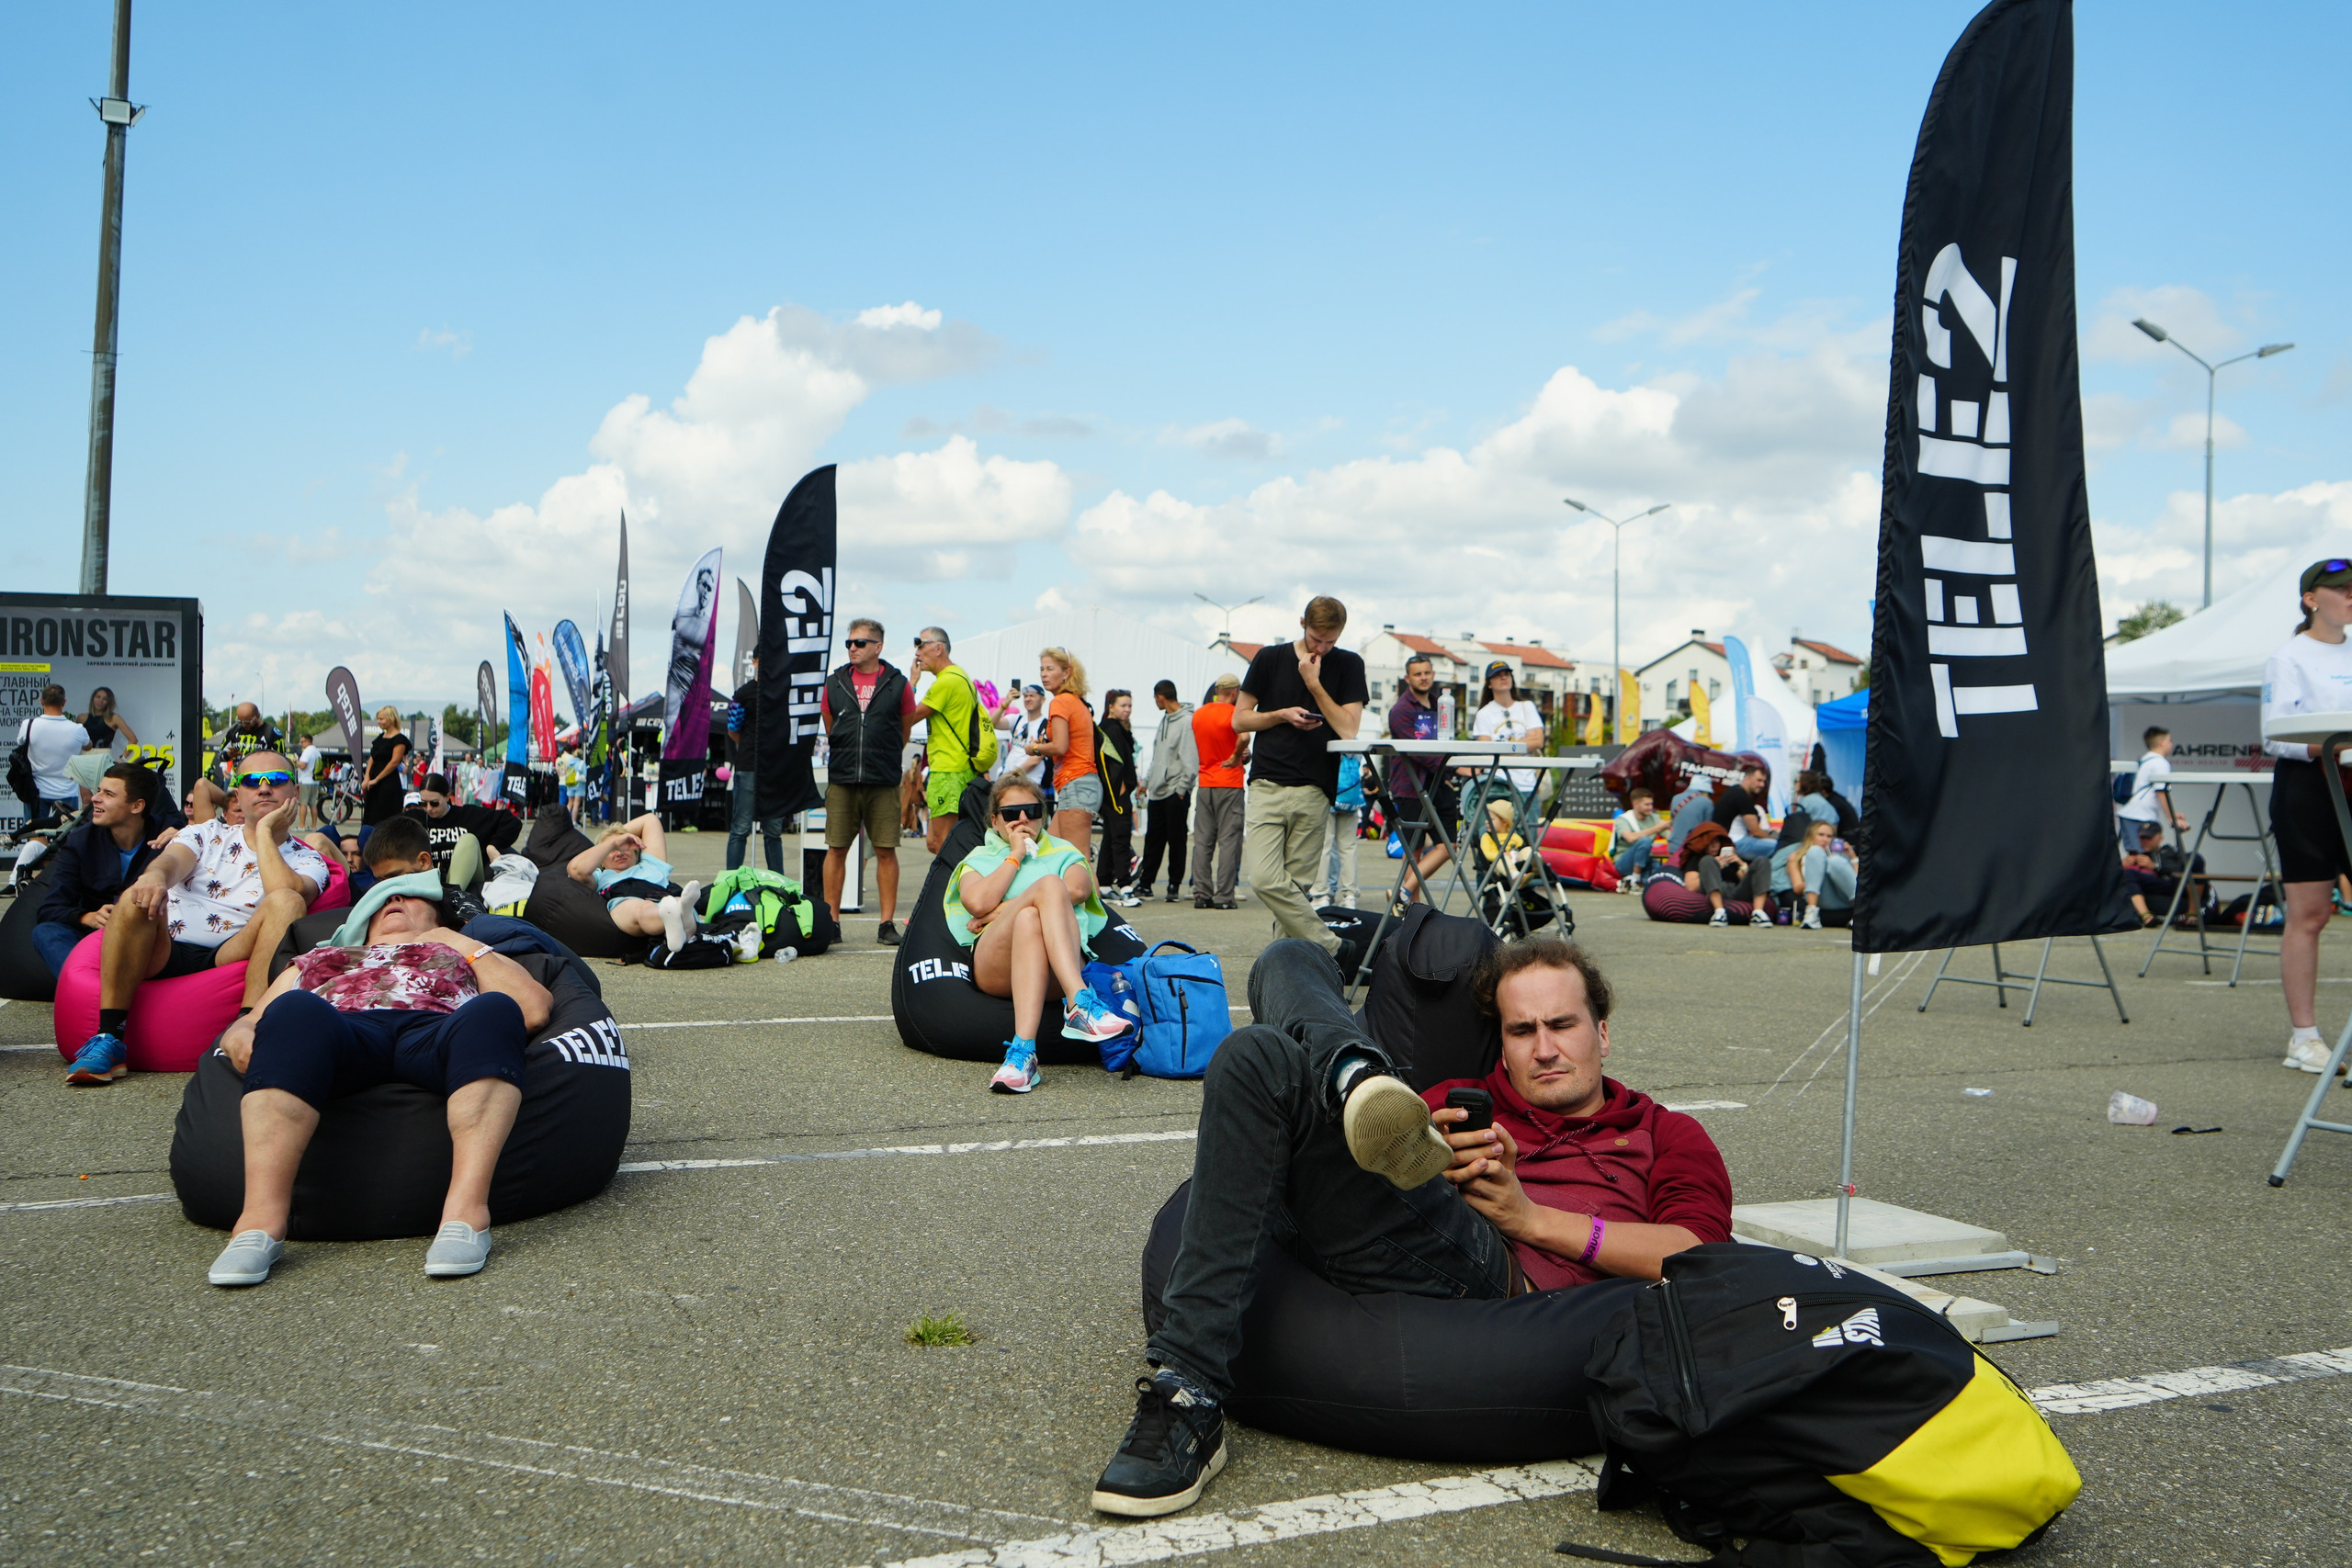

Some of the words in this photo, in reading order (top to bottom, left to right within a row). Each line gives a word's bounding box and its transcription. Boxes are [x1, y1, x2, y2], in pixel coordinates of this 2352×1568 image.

[1917, 242, 2039, 739] TELE2
[0, 617, 175, 658] IRONSTAR
[780, 567, 832, 745] TELE2
[126, 744, 175, 770] 226
[541, 1017, 630, 1071] TELE2
